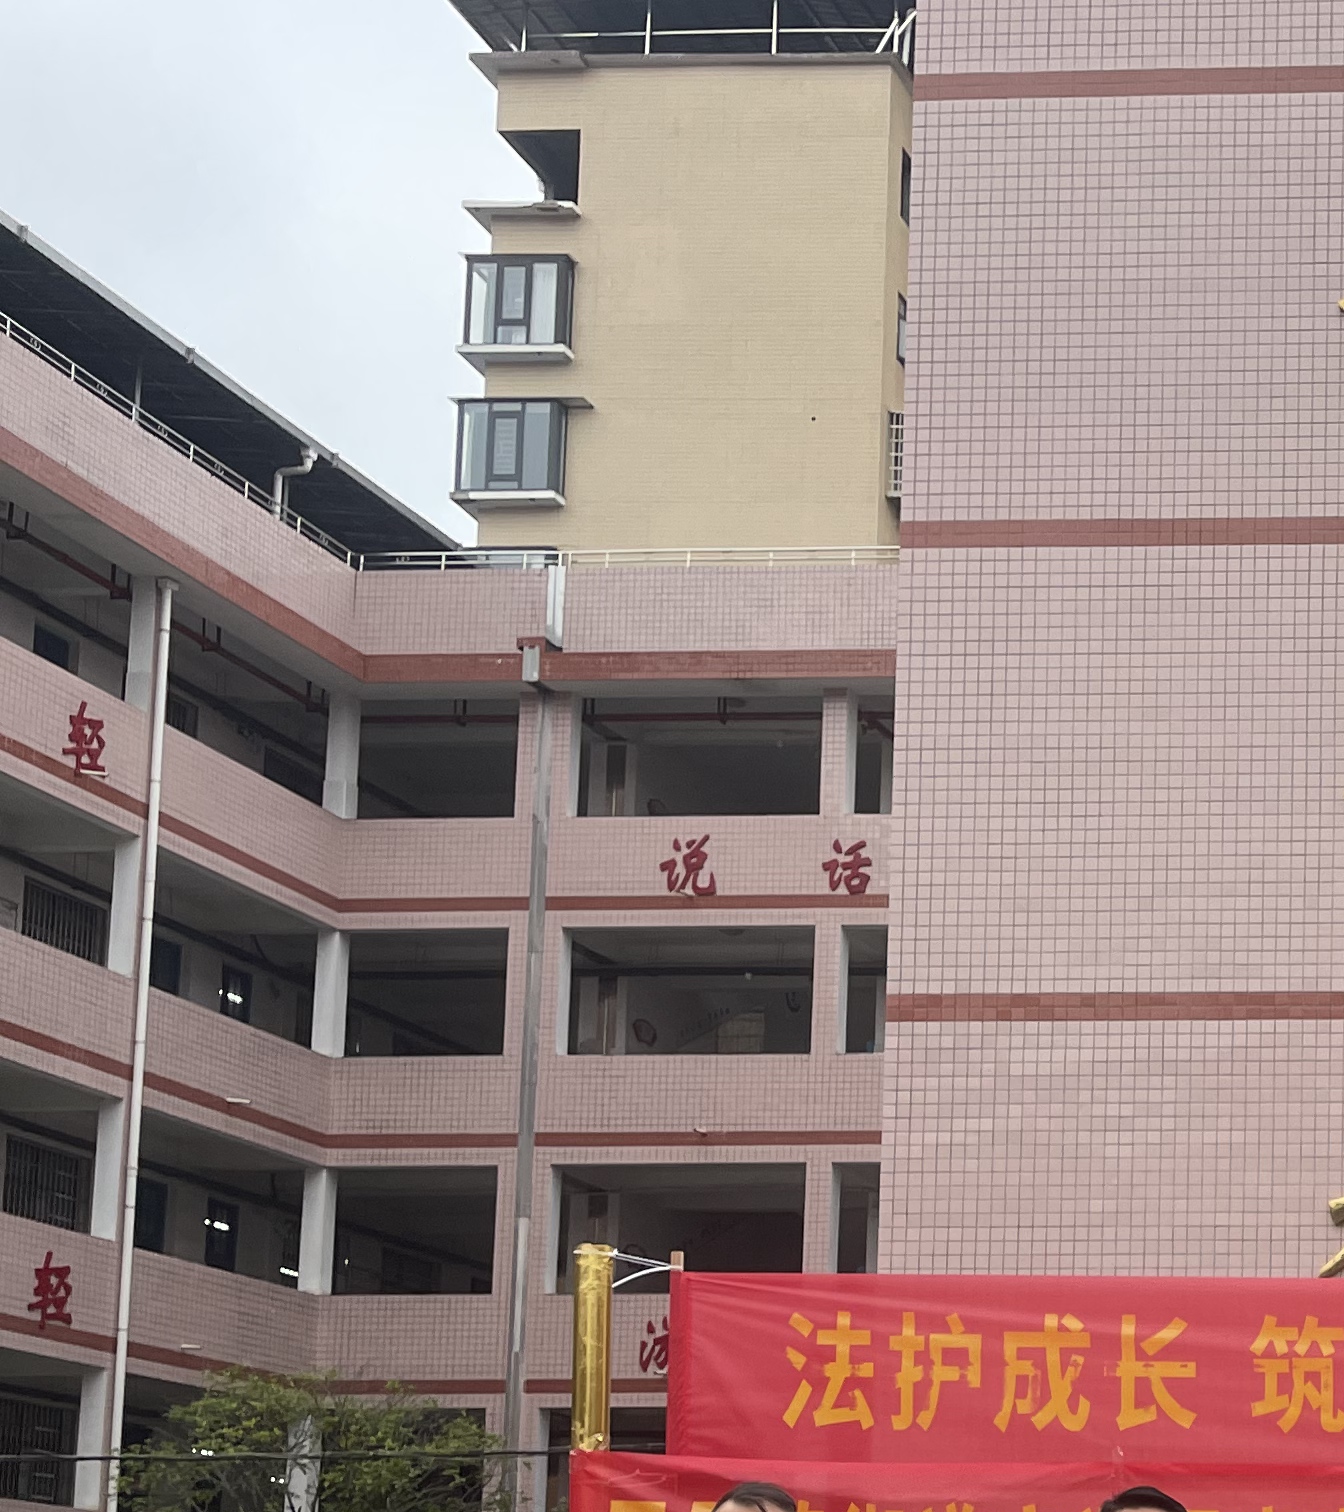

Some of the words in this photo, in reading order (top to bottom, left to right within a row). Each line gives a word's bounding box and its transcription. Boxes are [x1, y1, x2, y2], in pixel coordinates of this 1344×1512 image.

[62, 701, 106, 777] 轻
[27, 1251, 74, 1331] 轻
[781, 1311, 1198, 1435] 法护成长
